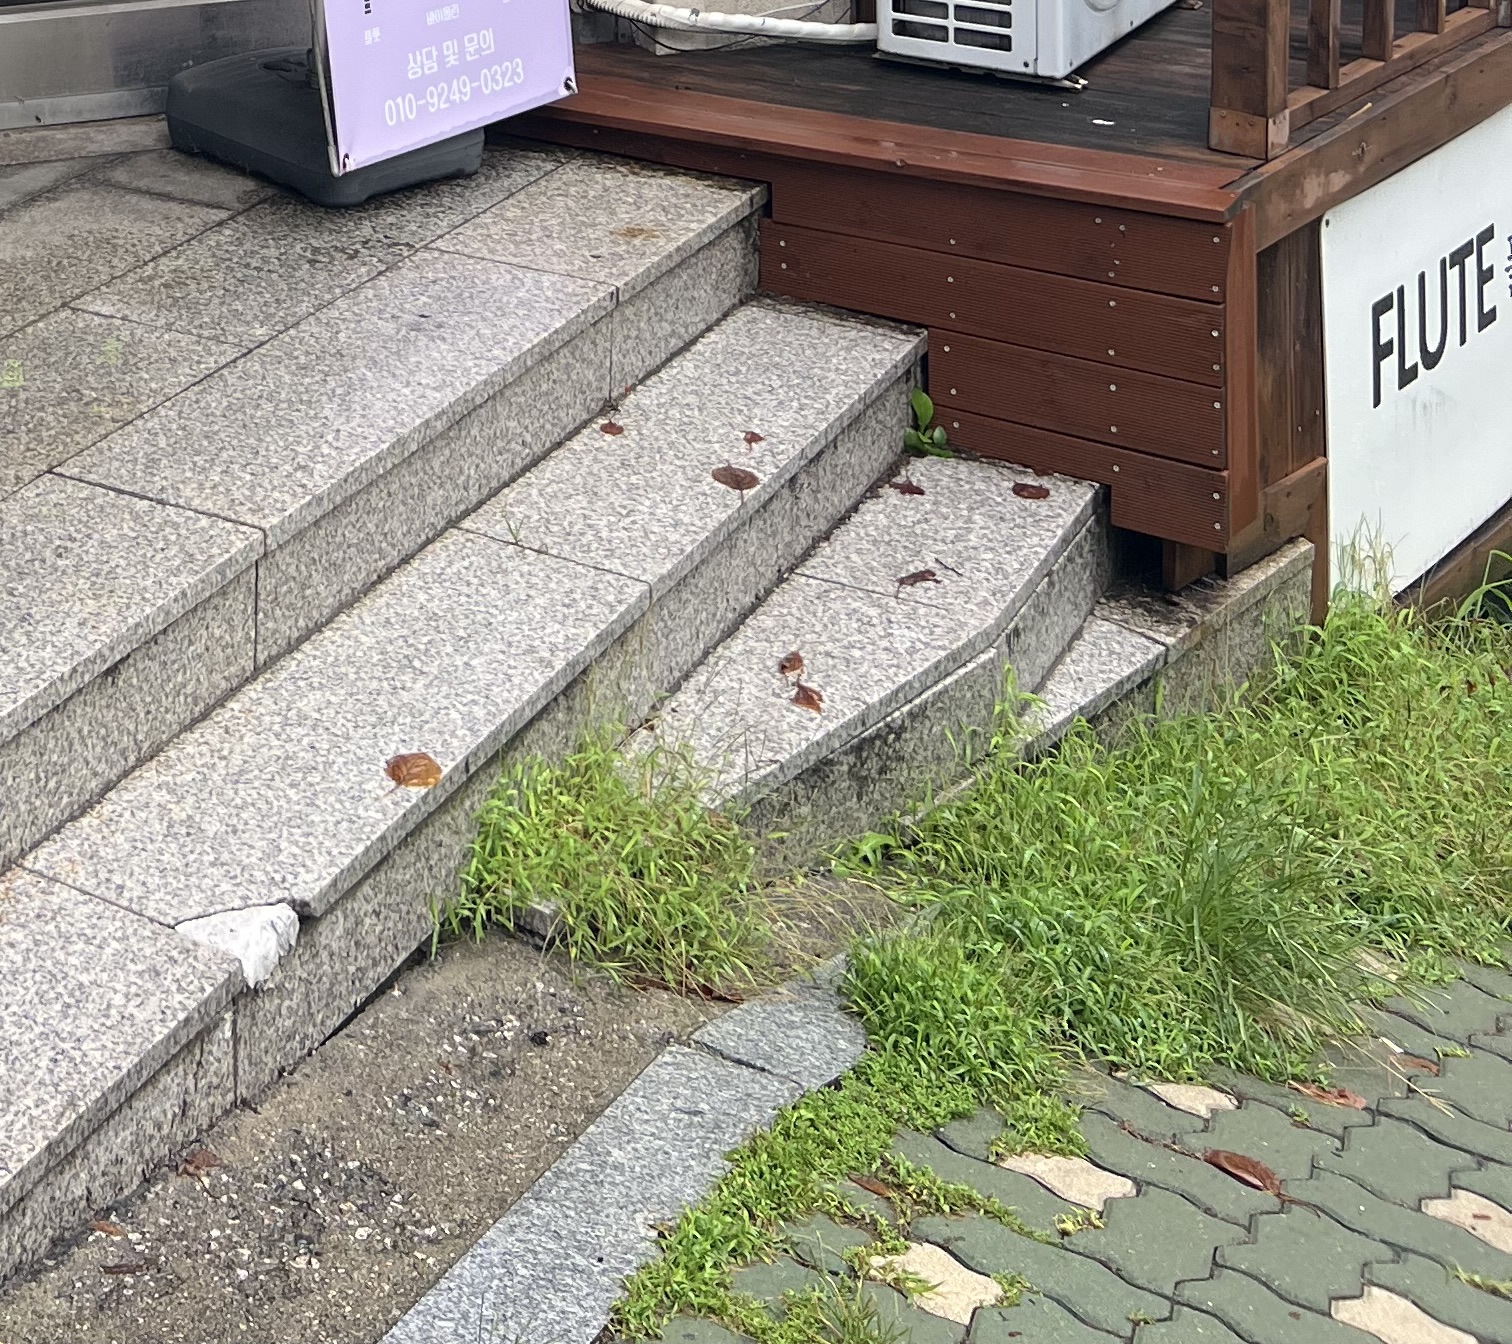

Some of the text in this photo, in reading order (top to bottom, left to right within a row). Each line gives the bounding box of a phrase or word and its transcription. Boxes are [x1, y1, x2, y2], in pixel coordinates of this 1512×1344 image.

[407, 27, 495, 80] 상담 및 문의
[384, 57, 525, 126] 010-9249-0323
[1371, 222, 1497, 409] FLUTE
